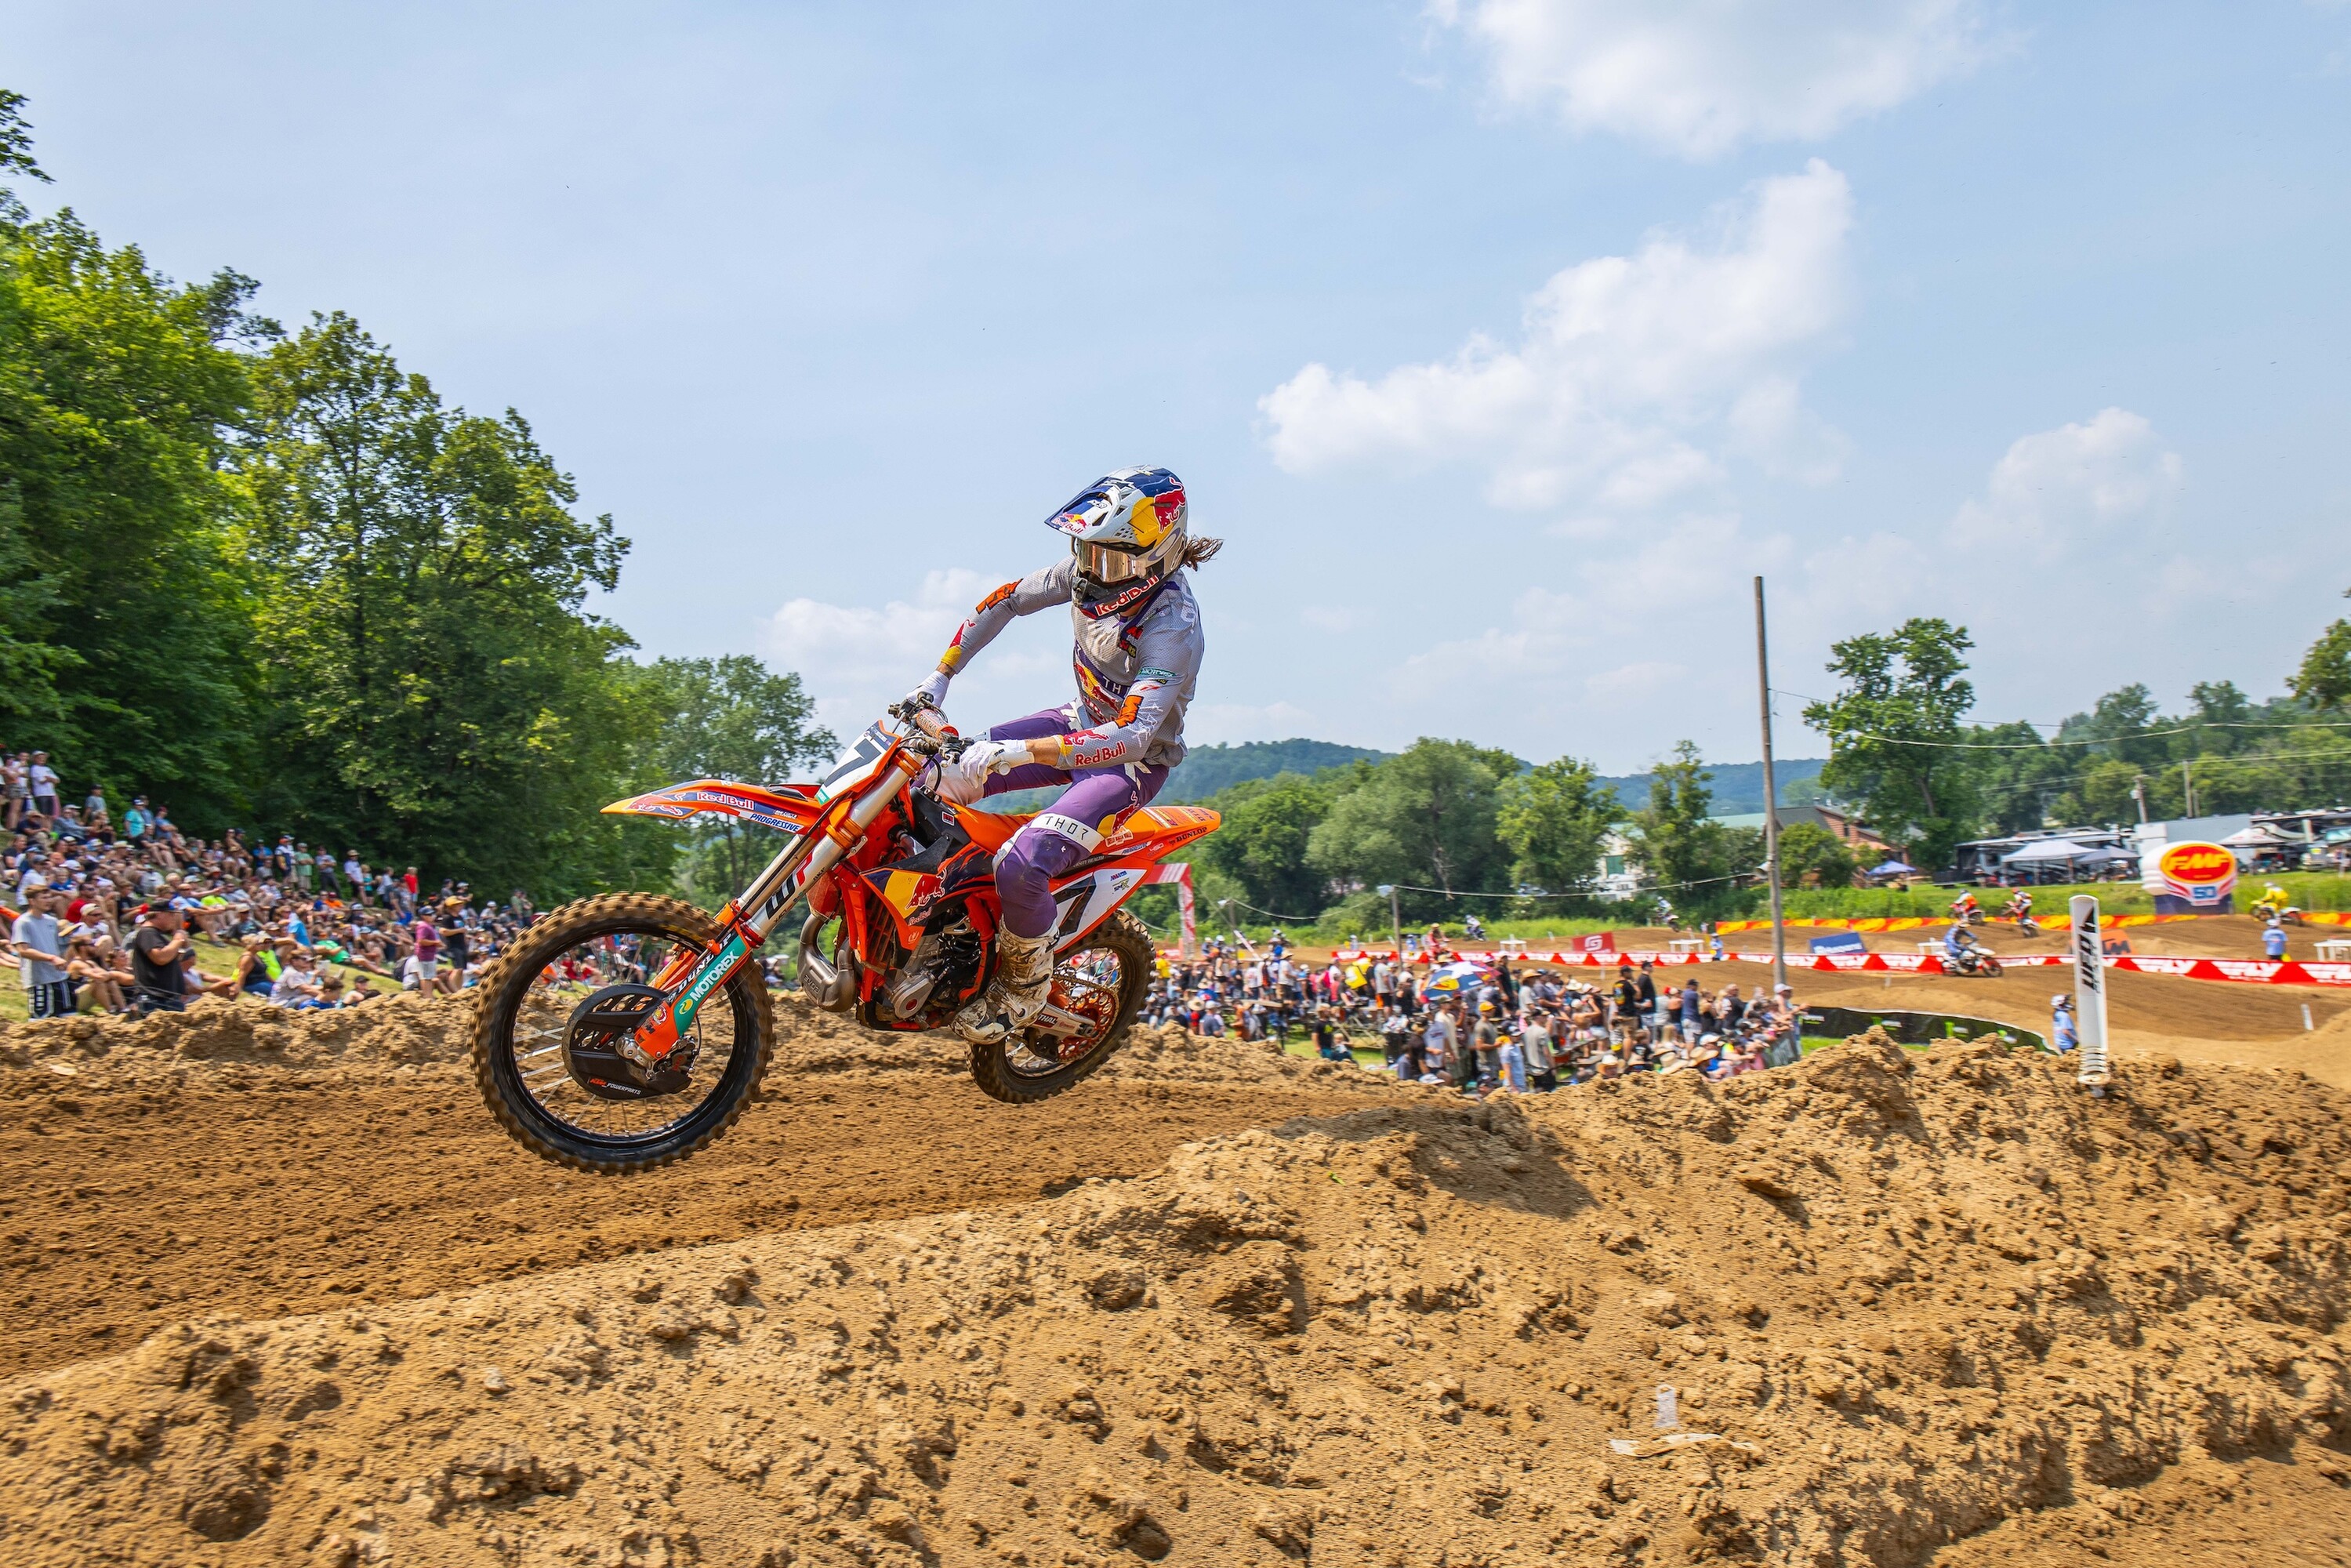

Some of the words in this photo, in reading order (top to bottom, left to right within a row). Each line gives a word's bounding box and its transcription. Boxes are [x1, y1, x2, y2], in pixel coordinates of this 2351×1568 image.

[1065, 522, 1084, 535] Bull
[1095, 592, 1130, 616] Red
[1075, 749, 1101, 766] Red
[1101, 741, 1127, 761] Bull
[823, 739, 882, 788] 7
[697, 792, 726, 804] Red
[726, 797, 754, 811] Bull
[749, 813, 800, 832] PROGRESSIVE
[1176, 826, 1207, 843] DUNLOP
[2166, 852, 2229, 872] FMF
[689, 949, 741, 1002] MOTOREX
[1038, 1014, 1057, 1025] THAL
[606, 1082, 642, 1095] POWERPARTS
